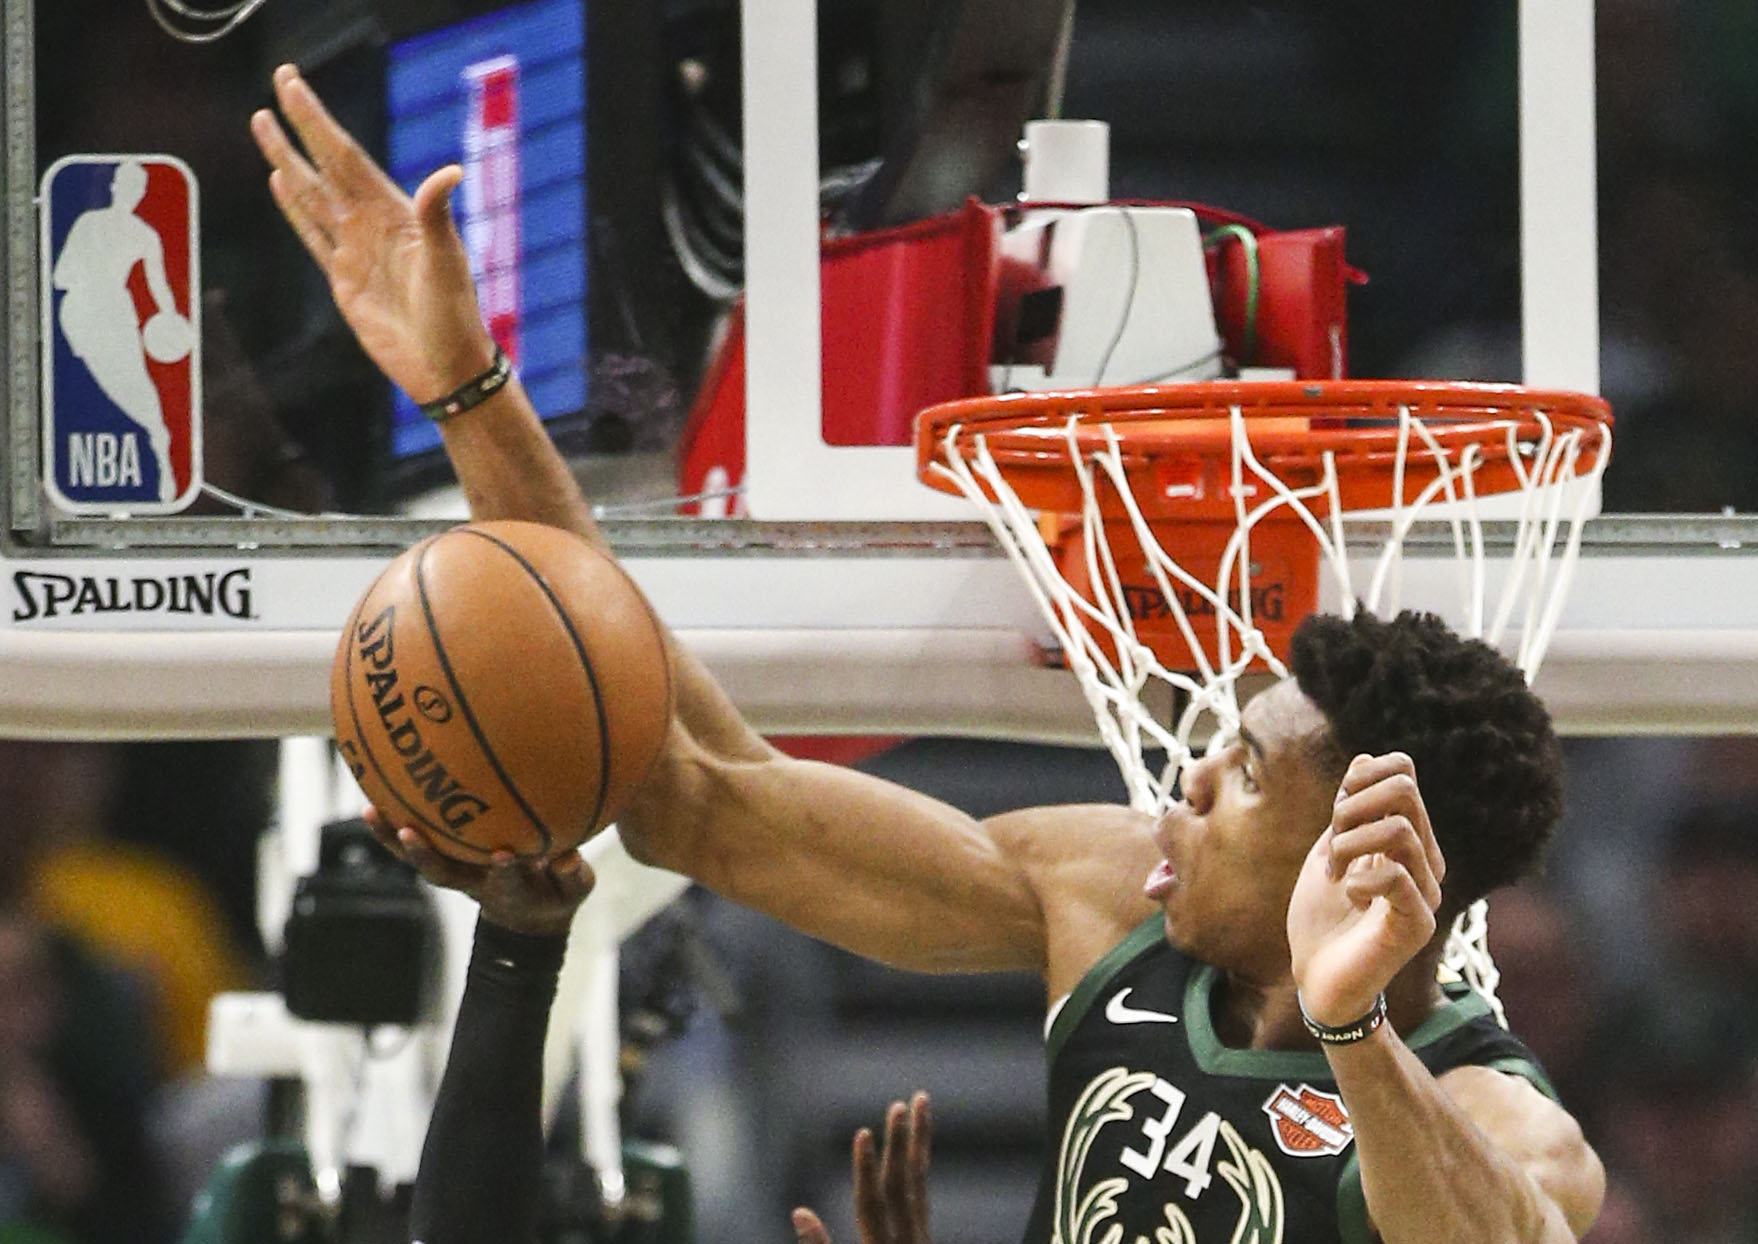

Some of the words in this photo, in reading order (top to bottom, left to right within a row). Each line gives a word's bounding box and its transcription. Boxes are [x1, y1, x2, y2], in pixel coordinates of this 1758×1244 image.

[69, 432, 142, 487] NBA
[13, 568, 259, 621] SPALDING
[357, 604, 491, 831] SPALDING
[1119, 1077, 1222, 1200] 34
